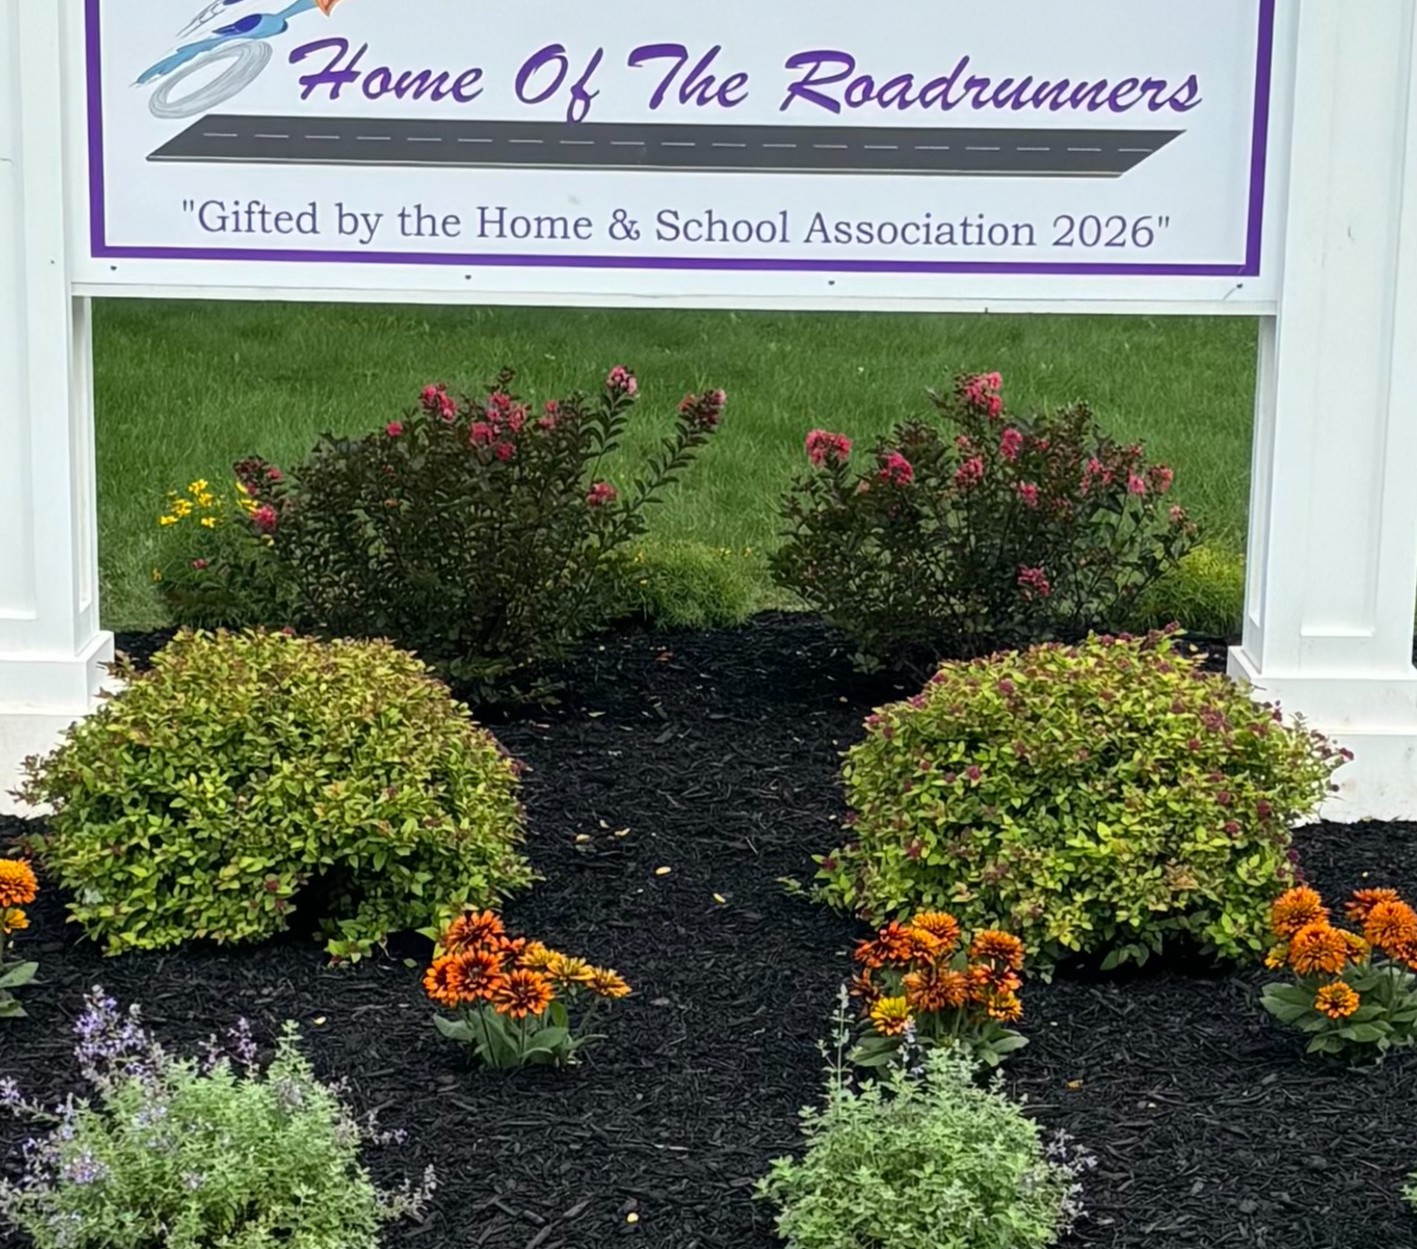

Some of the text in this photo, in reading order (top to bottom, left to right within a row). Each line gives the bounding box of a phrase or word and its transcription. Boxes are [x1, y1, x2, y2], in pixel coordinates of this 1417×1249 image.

[287, 36, 1204, 125] Home Of The Roadrunners
[181, 199, 1171, 249] "Gifted by the Home & School Association 2026"
